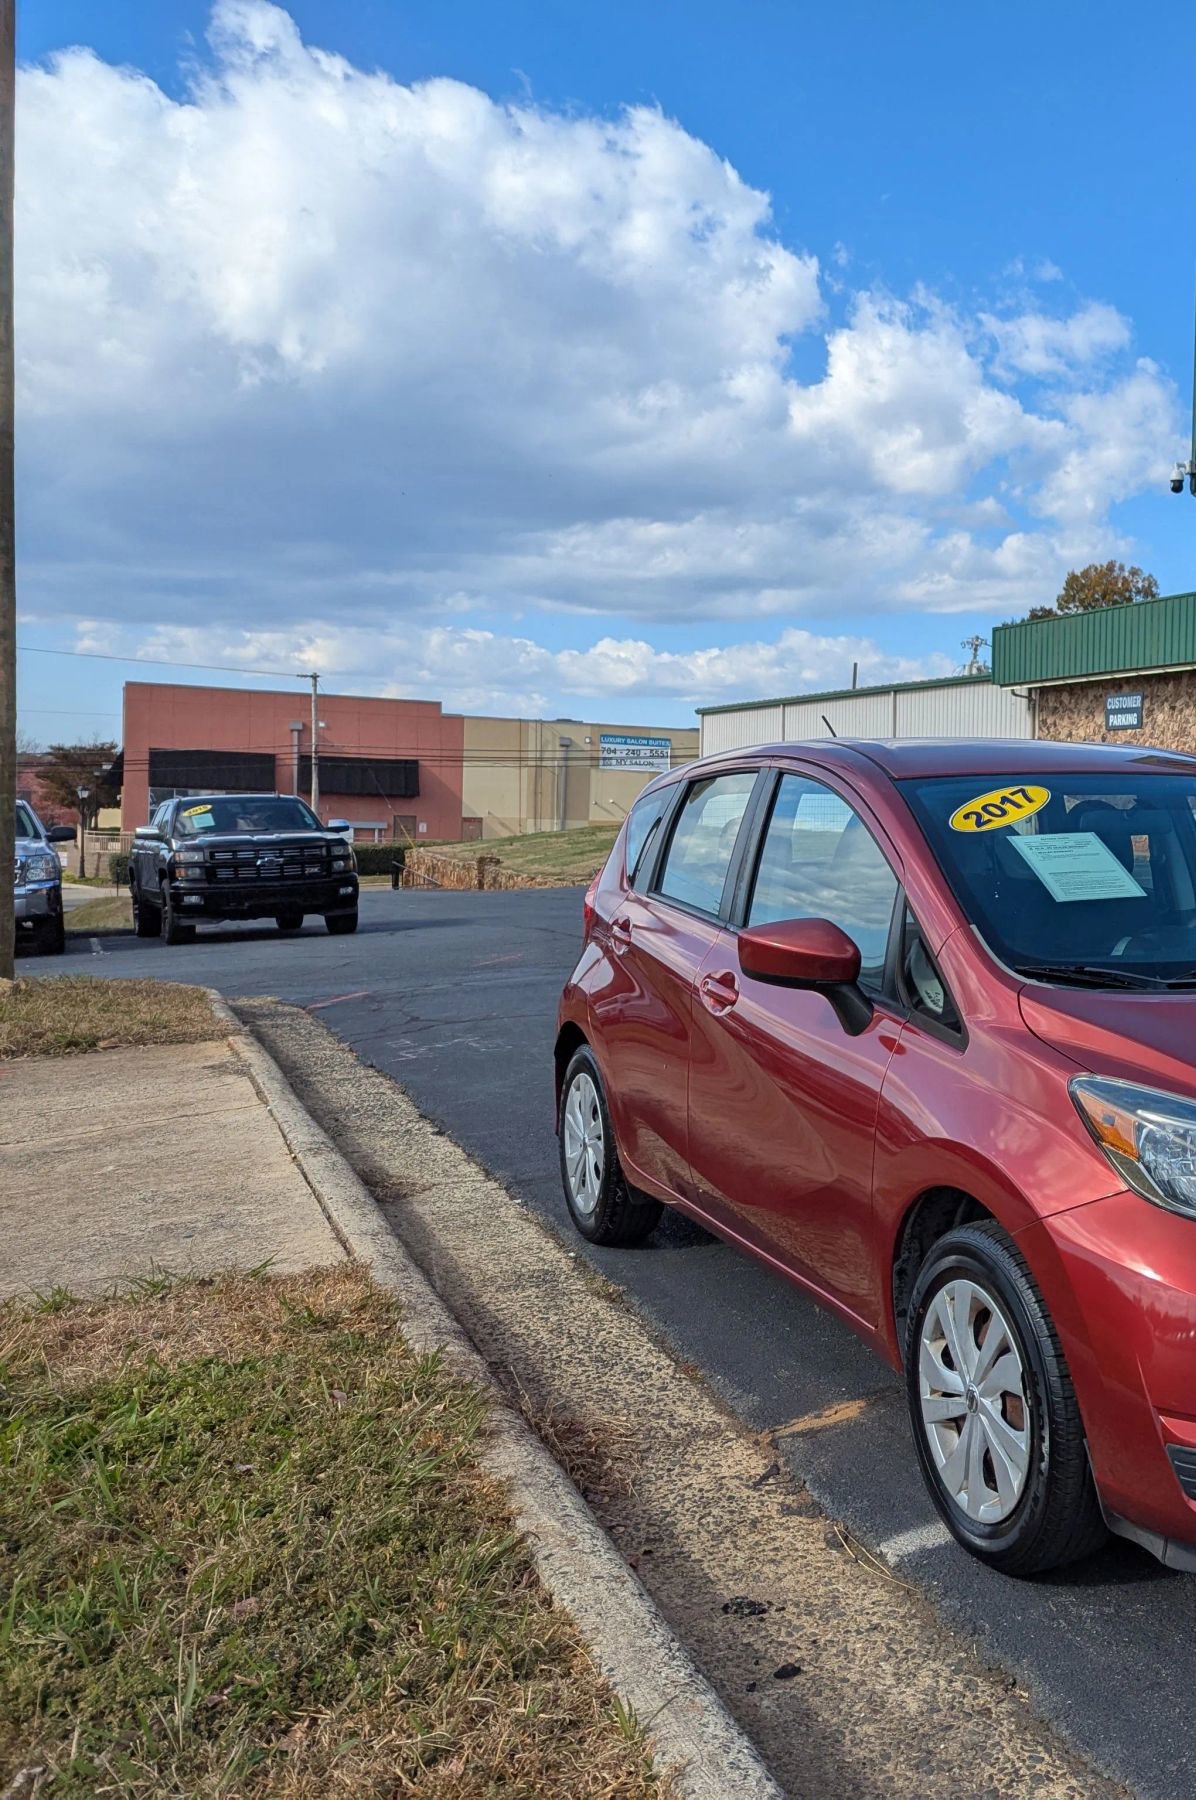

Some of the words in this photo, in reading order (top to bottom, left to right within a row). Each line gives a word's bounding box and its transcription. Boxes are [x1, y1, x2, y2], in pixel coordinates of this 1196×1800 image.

[1107, 695, 1142, 710] CUSTOMER
[1108, 713, 1138, 727] PARKING
[601, 736, 626, 744] LUXURY
[963, 788, 1034, 828] 2017
